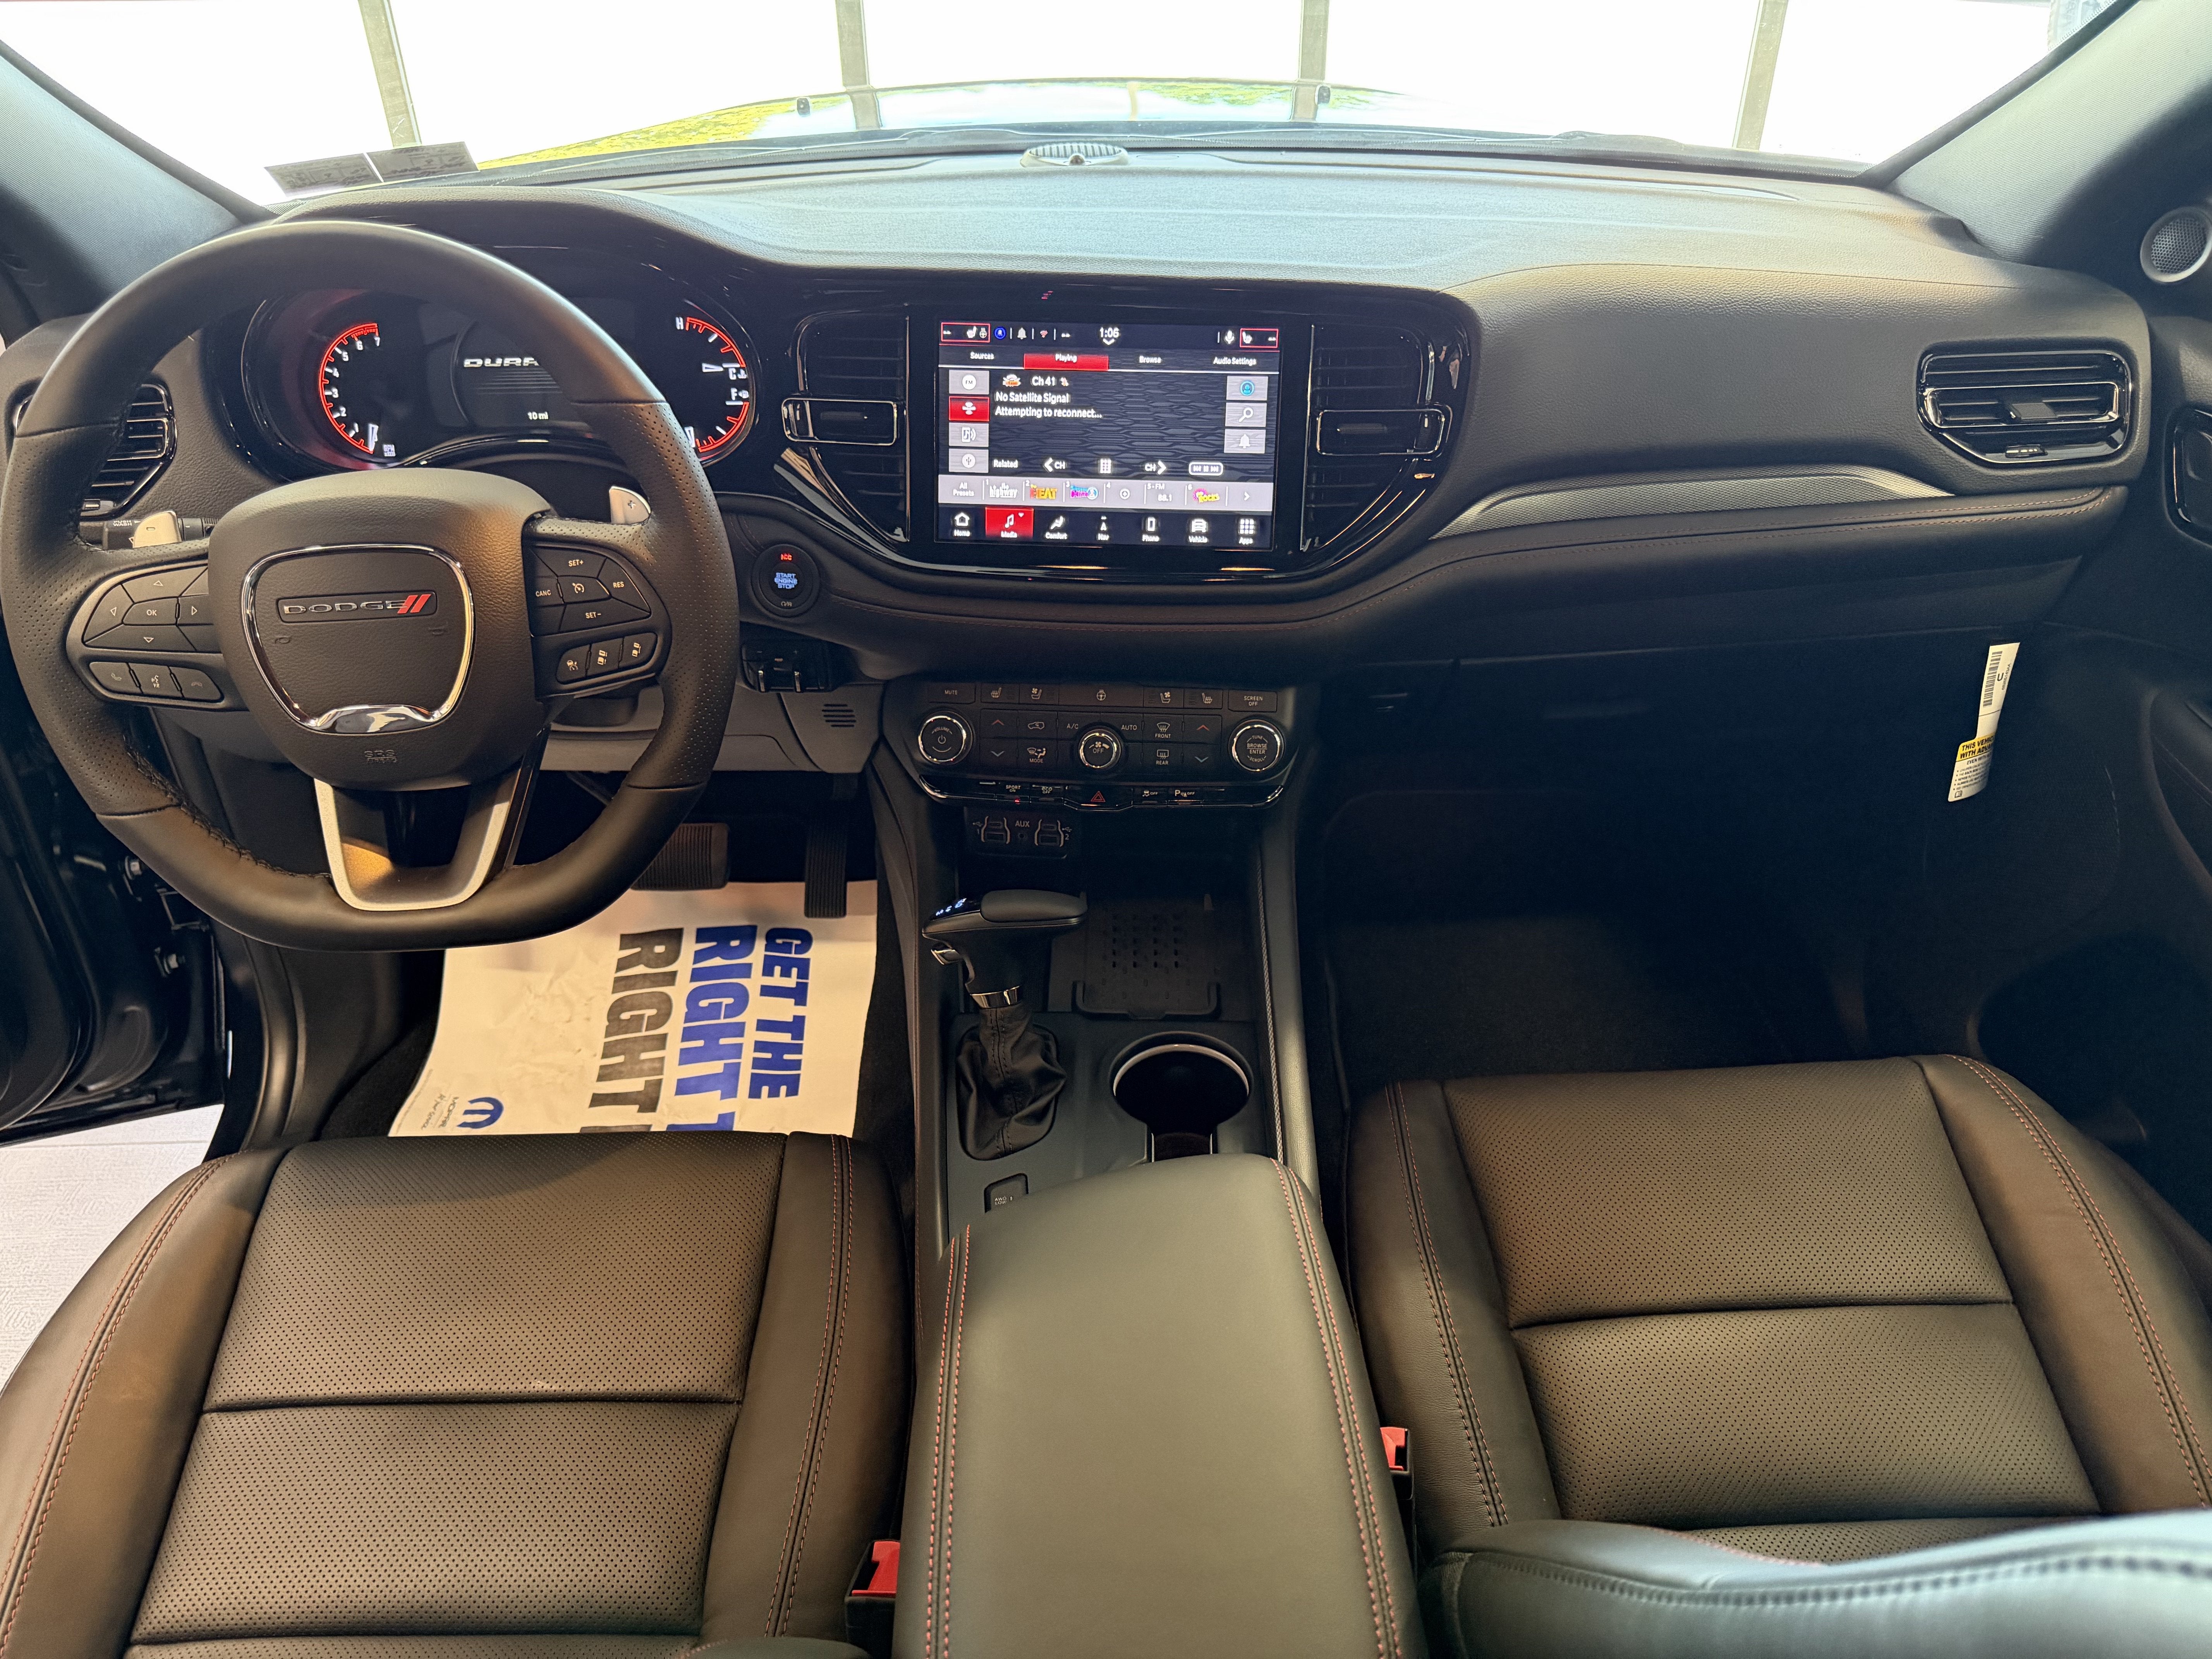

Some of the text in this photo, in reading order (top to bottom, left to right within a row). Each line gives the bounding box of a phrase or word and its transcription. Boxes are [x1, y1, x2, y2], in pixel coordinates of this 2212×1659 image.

[1100, 327, 1120, 338] 1:06
[356, 340, 363, 350] 6
[342, 351, 349, 361] 5
[970, 351, 994, 360] Sources
[1055, 353, 1077, 363] Playing
[1139, 355, 1162, 364] Browse
[1213, 357, 1257, 366] Audio Settings
[1032, 376, 1044, 386] Ch
[1045, 377, 1056, 386] 41
[331, 387, 339, 398] 3
[996, 392, 1070, 404] No Satellite Signal
[339, 406, 347, 417] 2
[538, 411, 549, 420] mi
[995, 405, 1103, 418] Attempting to reconnect...
[993, 459, 1018, 468] Related
[1054, 461, 1066, 469] CH
[1144, 463, 1156, 471] CH
[1030, 488, 1057, 500] HEAT
[283, 600, 408, 614] DODGE
[1962, 742, 1976, 752] THIS
[1960, 749, 1976, 759] WITH
[674, 925, 758, 1101] RIGHT
[748, 927, 813, 1099] GET THE
[588, 927, 684, 1113] RIGHT
